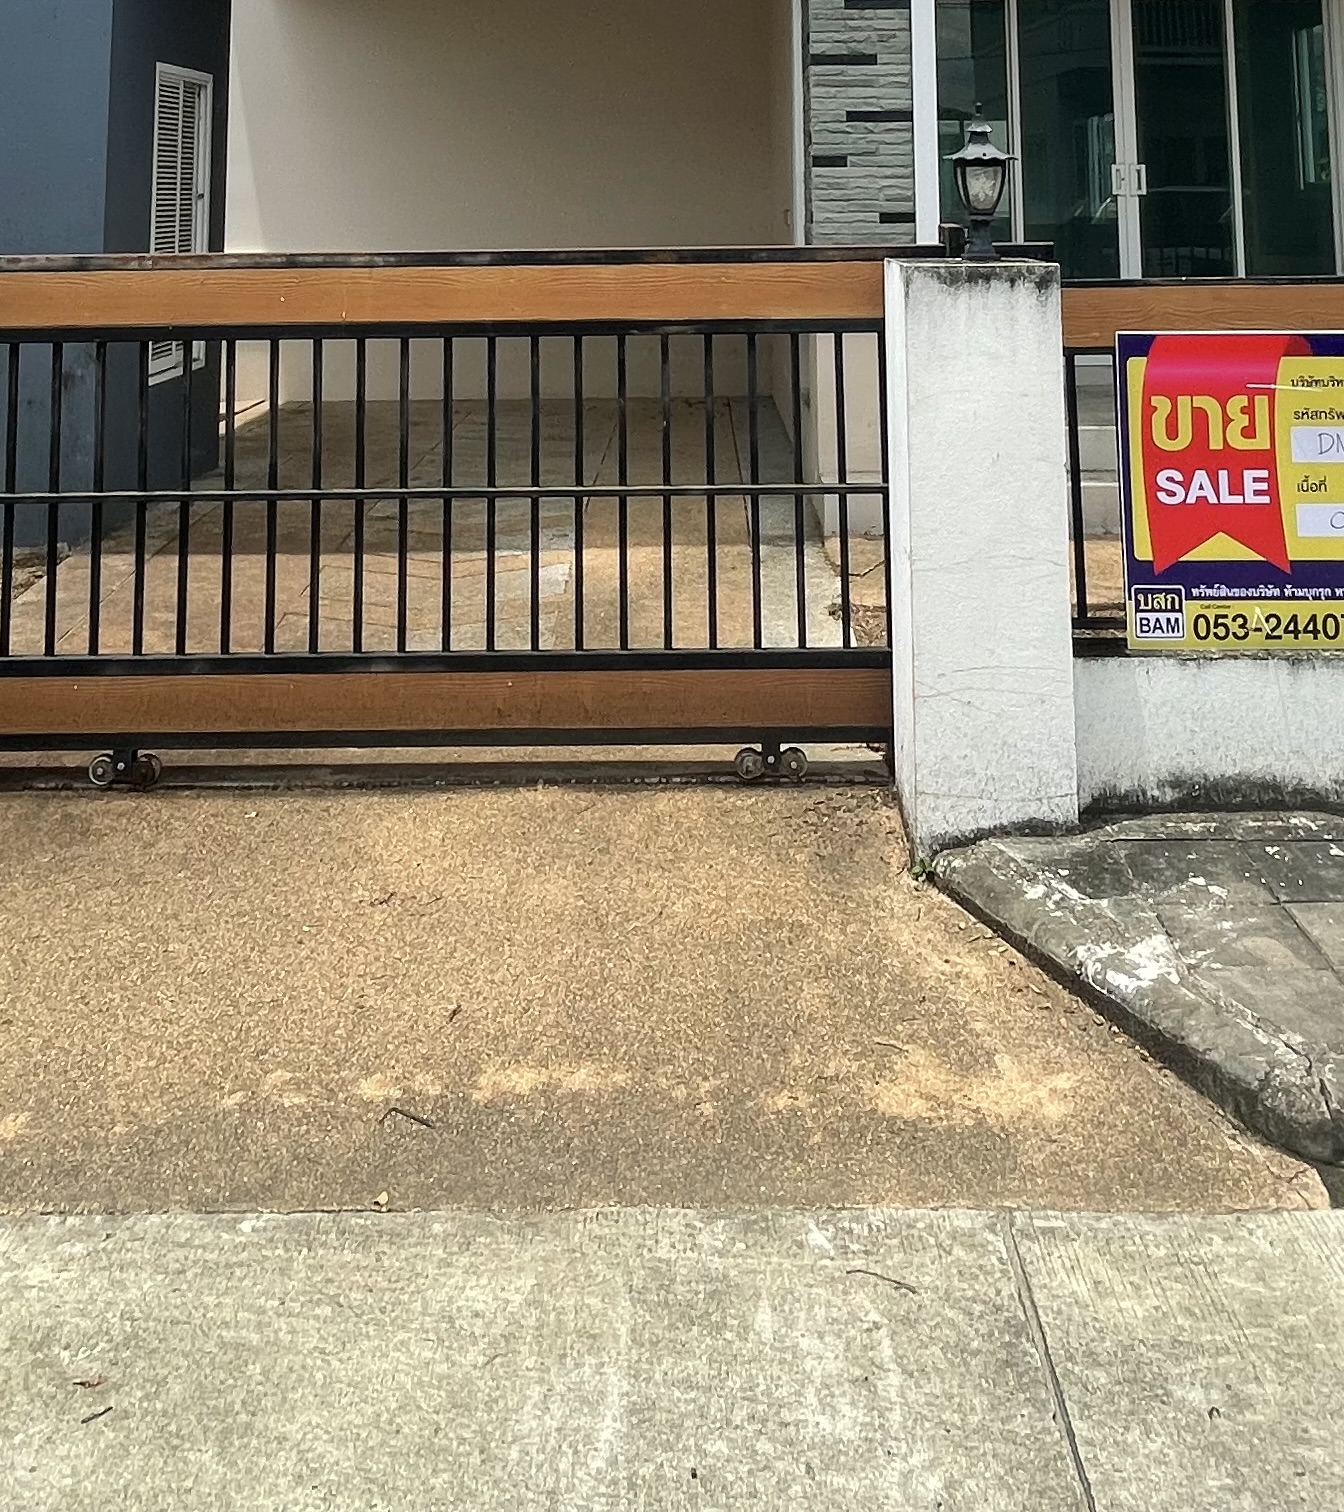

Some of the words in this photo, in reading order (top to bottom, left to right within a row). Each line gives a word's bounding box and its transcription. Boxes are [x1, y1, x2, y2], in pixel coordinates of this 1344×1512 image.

[1150, 395, 1271, 451] ขาย
[1156, 469, 1271, 505] SALE
[1297, 474, 1328, 493] เนื้อที่
[1137, 592, 1179, 610] บสก
[1284, 584, 1332, 600] ห้ามบุกรุก
[1139, 617, 1180, 634] BAM
